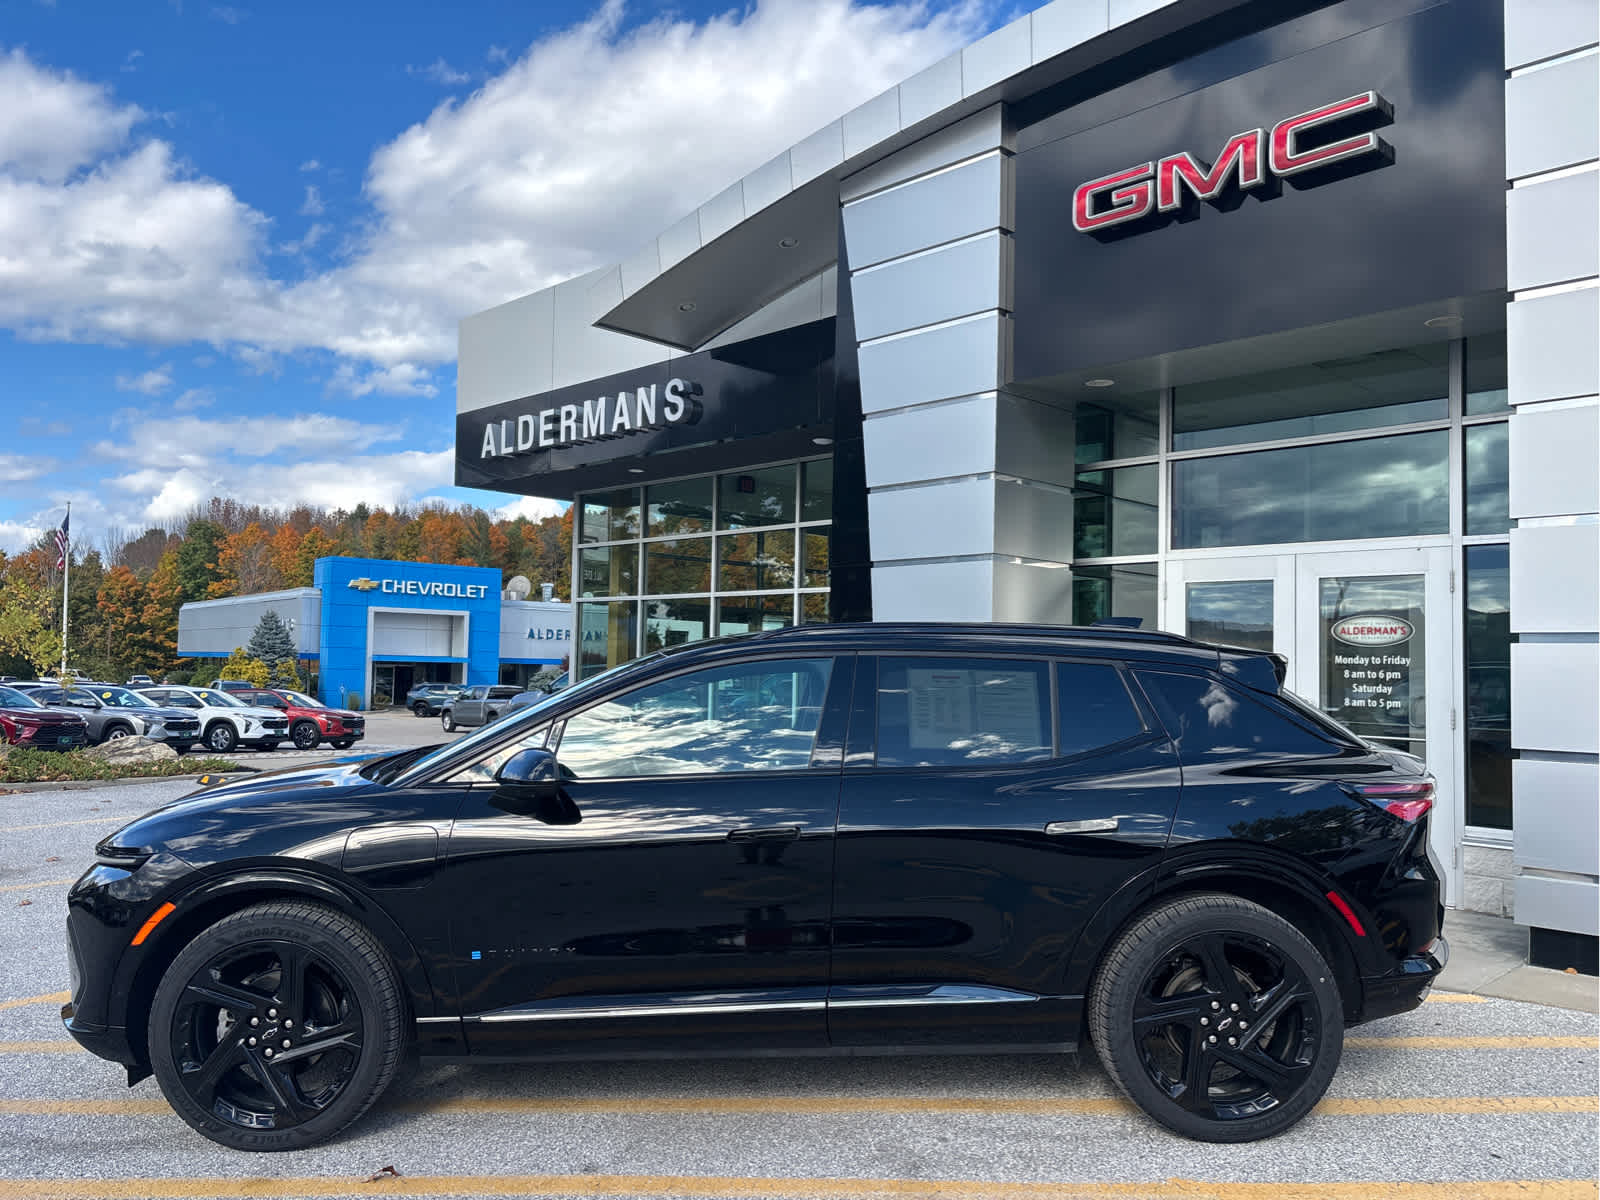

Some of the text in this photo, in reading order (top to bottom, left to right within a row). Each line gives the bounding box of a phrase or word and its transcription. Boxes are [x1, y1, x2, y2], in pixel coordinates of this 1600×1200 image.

[1072, 89, 1378, 233] GMC
[480, 377, 688, 459] ALDERMANS
[381, 579, 488, 599] CHEVROLET
[1340, 626, 1407, 636] ALDERMAN'S
[1334, 655, 1411, 667] Monday to Friday
[1344, 670, 1401, 681] 8 am to 6 pm
[1352, 683, 1393, 695] Saturday
[1344, 698, 1401, 710] 8 am to 5 pm
